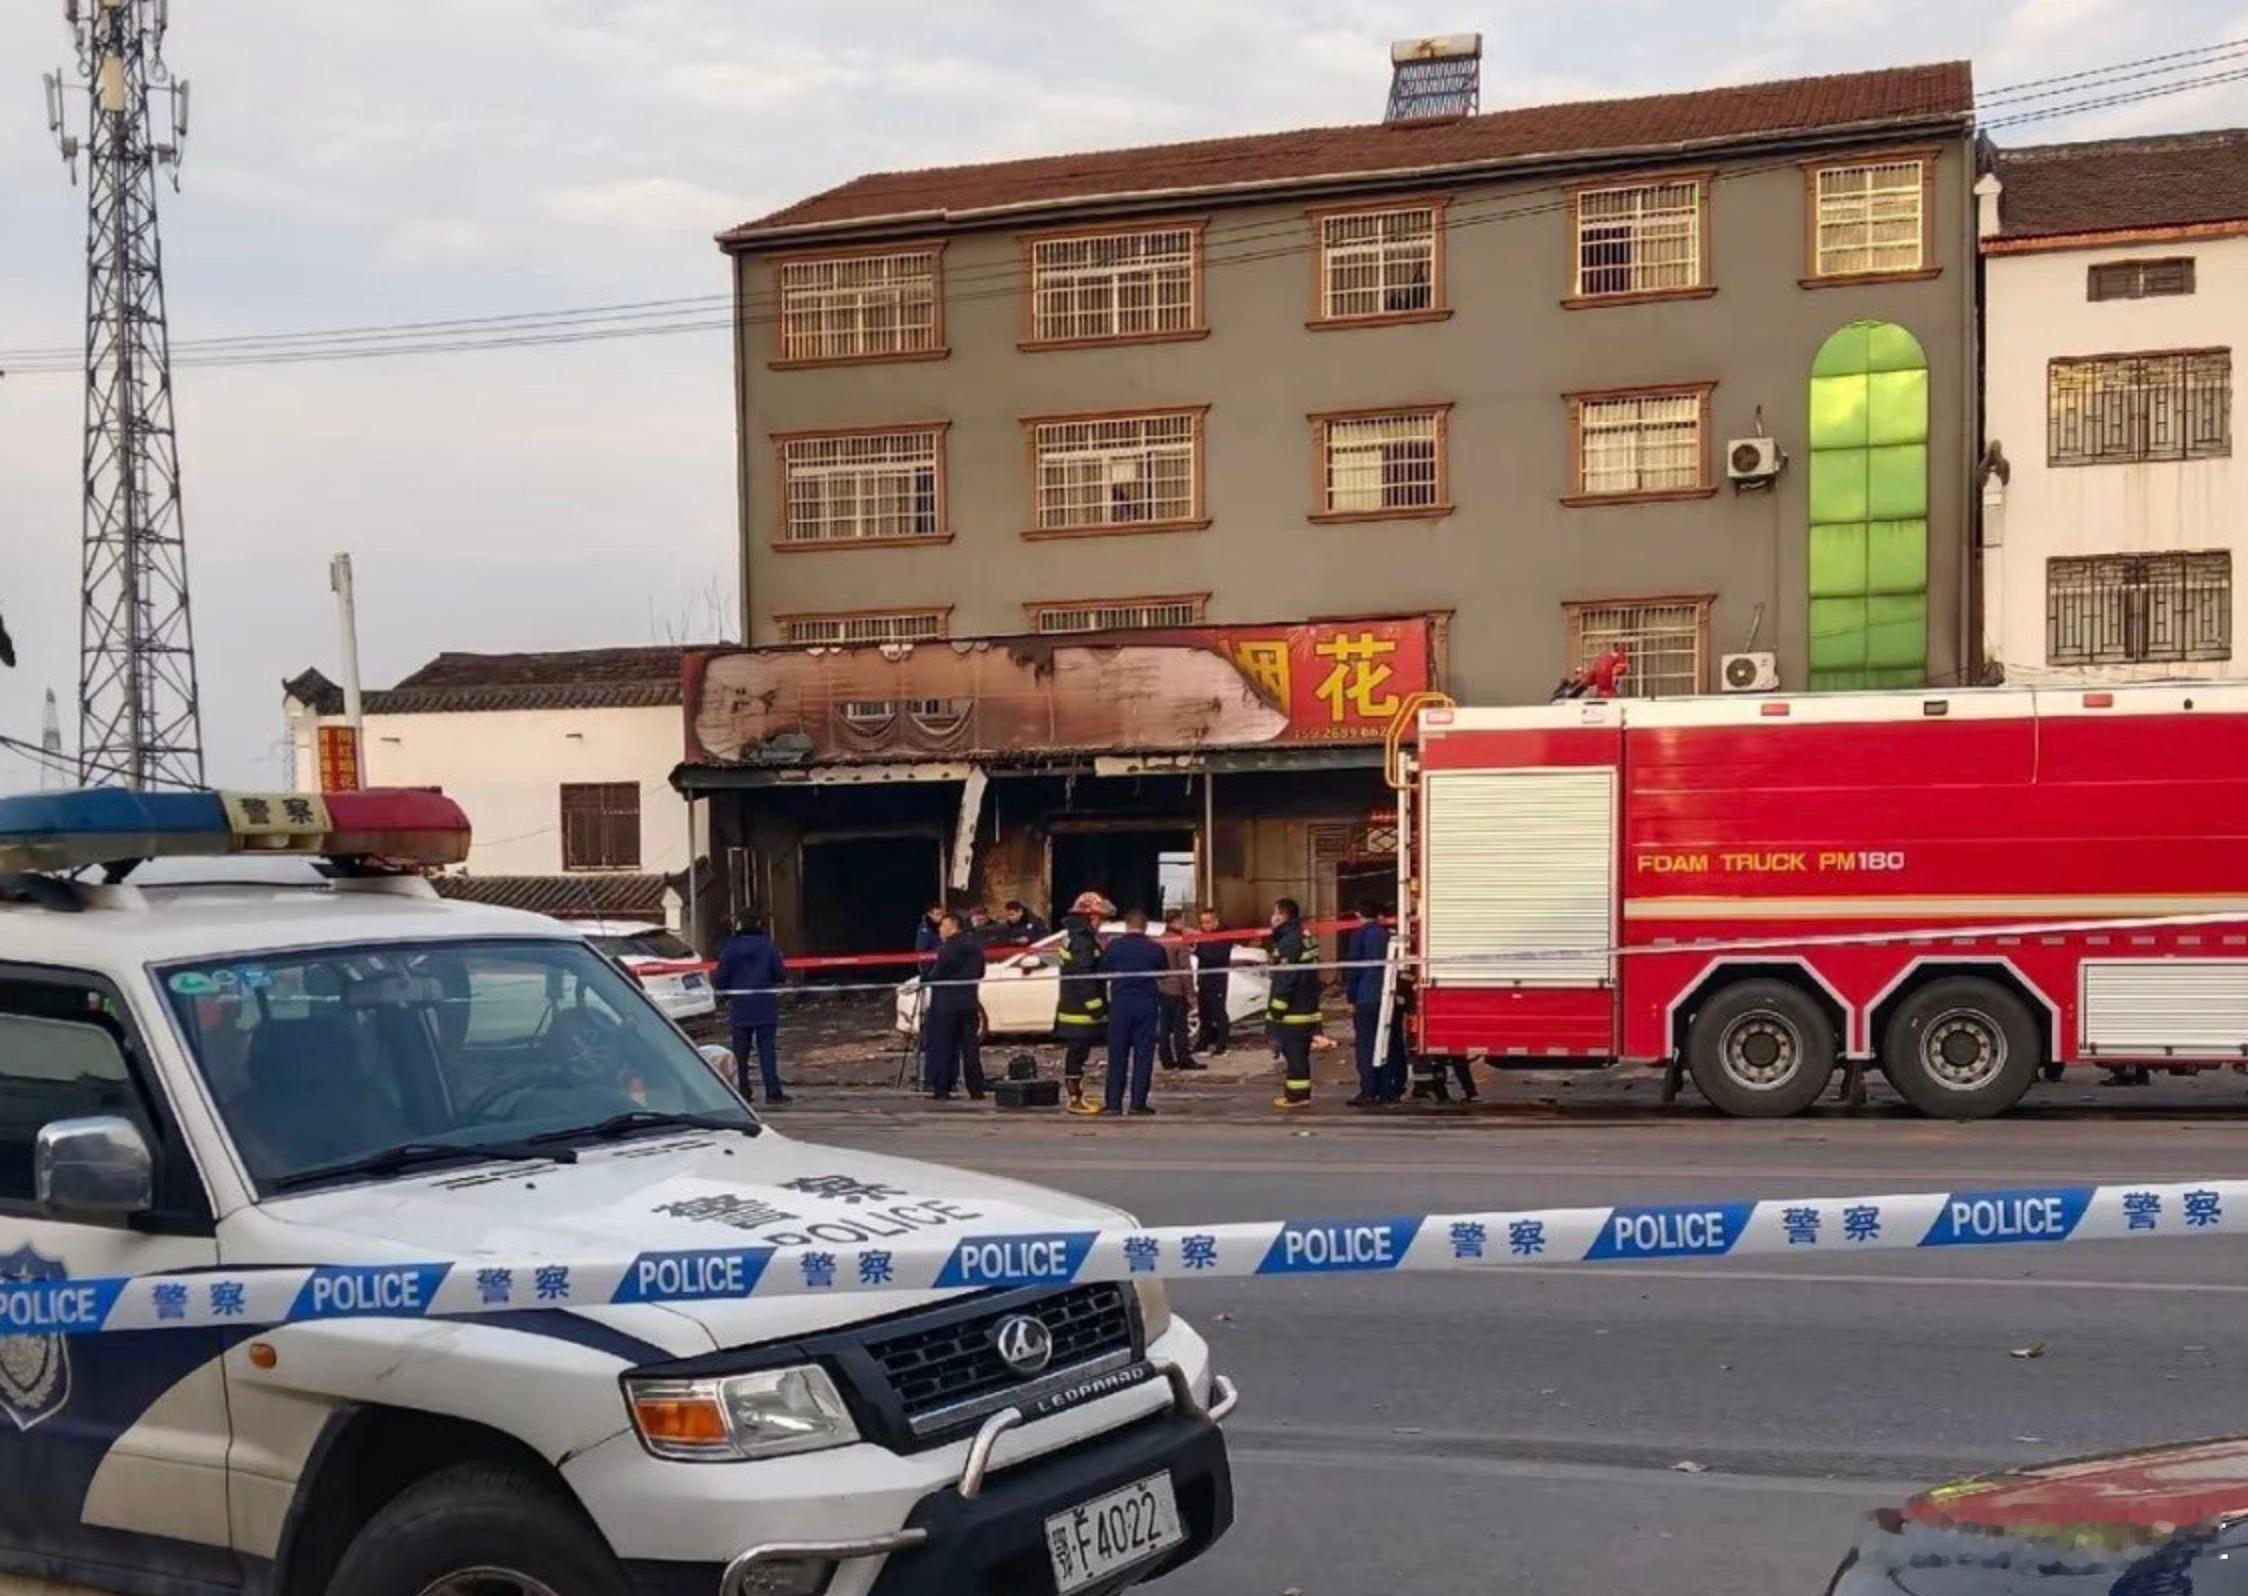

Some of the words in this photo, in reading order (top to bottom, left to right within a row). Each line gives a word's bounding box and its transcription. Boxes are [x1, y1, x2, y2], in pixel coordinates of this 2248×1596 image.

[241, 798, 314, 824] 警察
[1637, 855, 1708, 873] FOAM
[1720, 853, 1807, 872] TRUCK
[1819, 852, 1904, 871] PM180
[151, 1281, 245, 1320] 警察
[313, 1271, 420, 1312] POLICE
[476, 1264, 569, 1304] 警察
[638, 1255, 745, 1296] POLICE
[801, 1248, 893, 1288] 警察
[961, 1240, 1068, 1280] POLICE
[1123, 1233, 1217, 1273] 警察
[1285, 1225, 1393, 1266] POLICE
[1450, 1219, 1545, 1259] 警察
[1615, 1212, 1724, 1251] POLICE
[1782, 1203, 1881, 1245] 警察
[1952, 1197, 2064, 1237] POLICE
[2122, 1188, 2222, 1231] 警察
